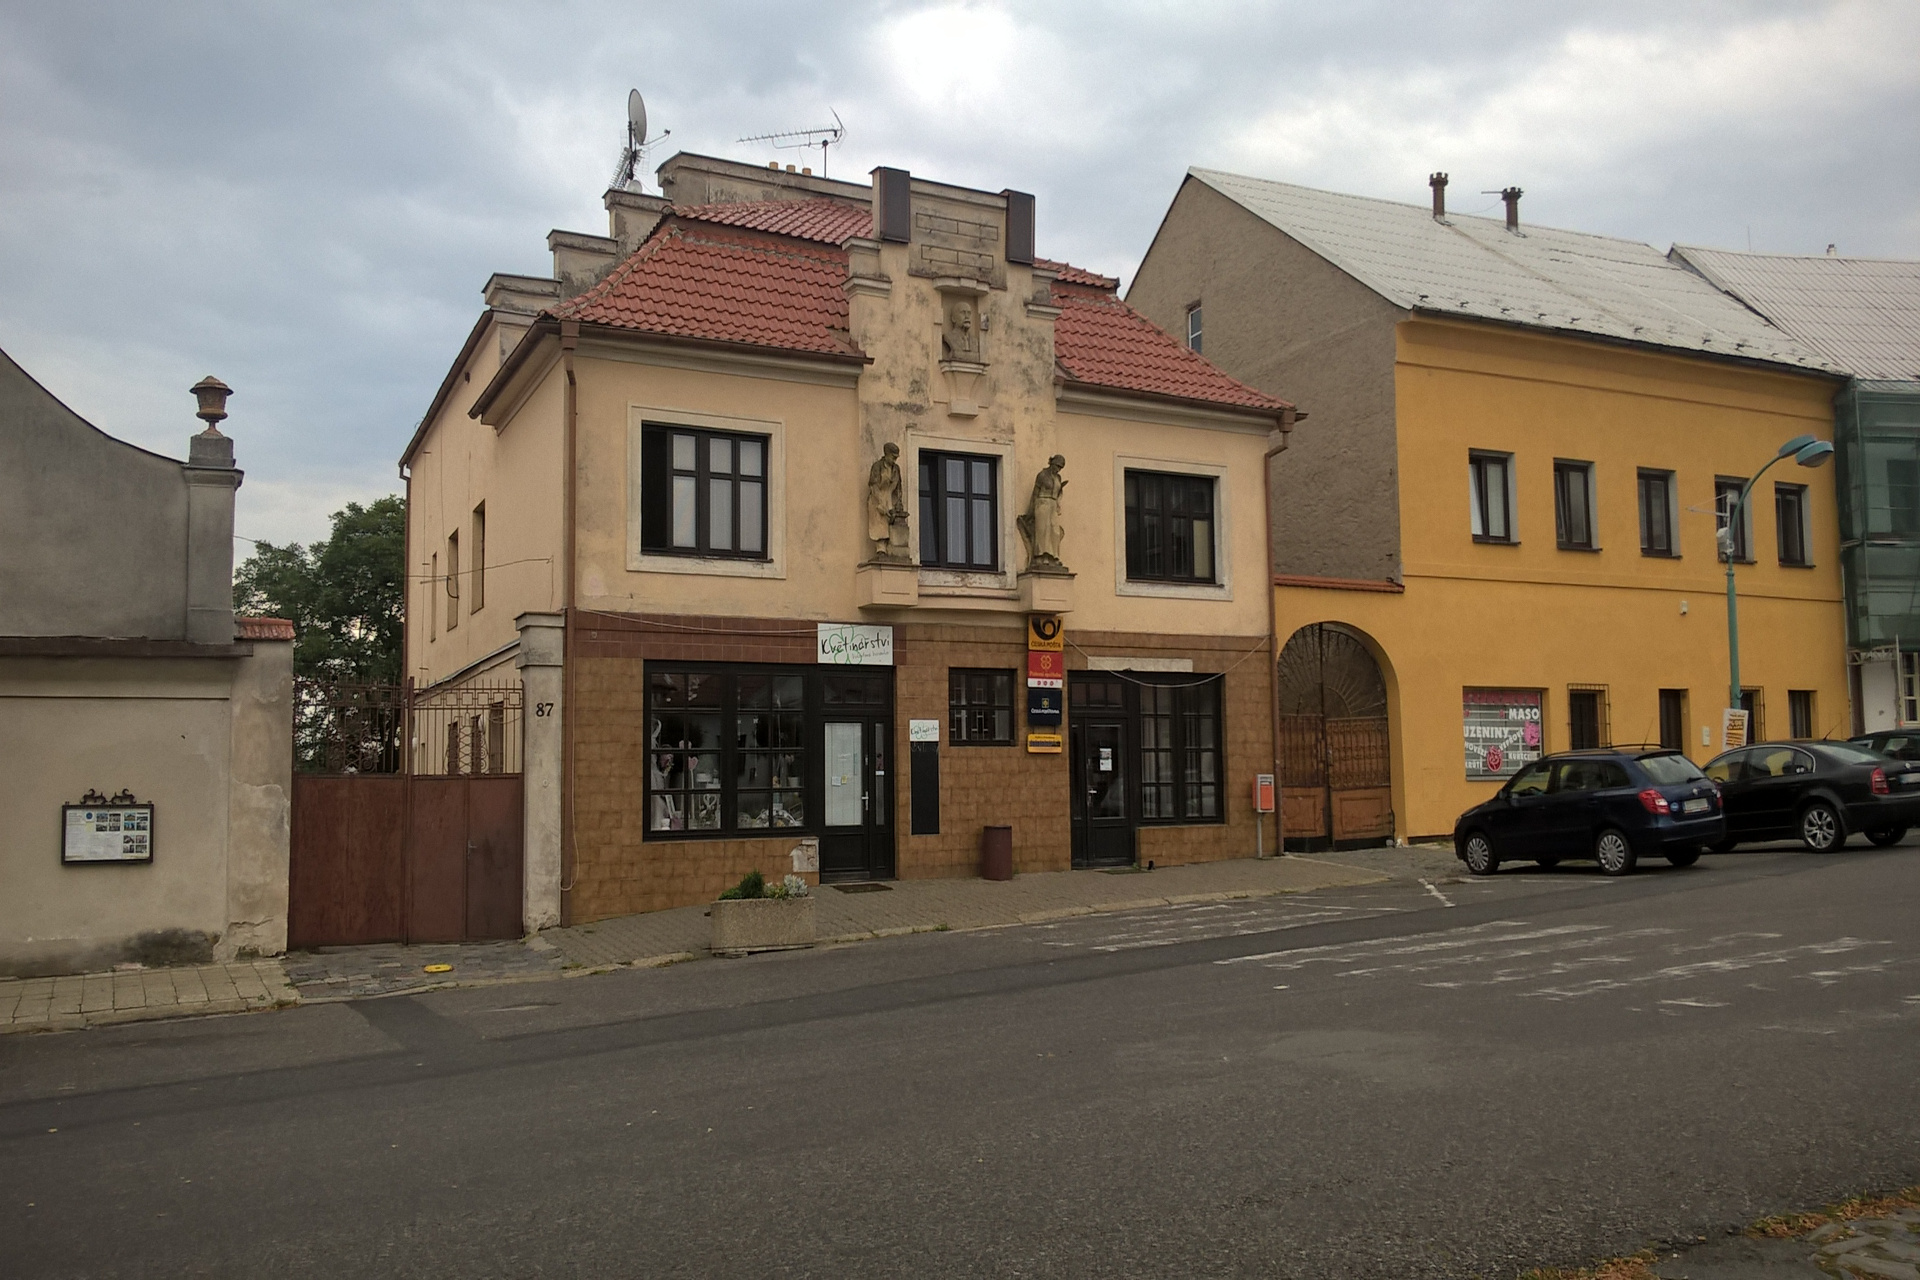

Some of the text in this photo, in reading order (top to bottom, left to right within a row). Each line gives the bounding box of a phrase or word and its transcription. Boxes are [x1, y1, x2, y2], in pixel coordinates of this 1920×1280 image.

[536, 702, 554, 717] 87
[1508, 708, 1539, 720] MASO
[1463, 726, 1509, 738] UZENINY
